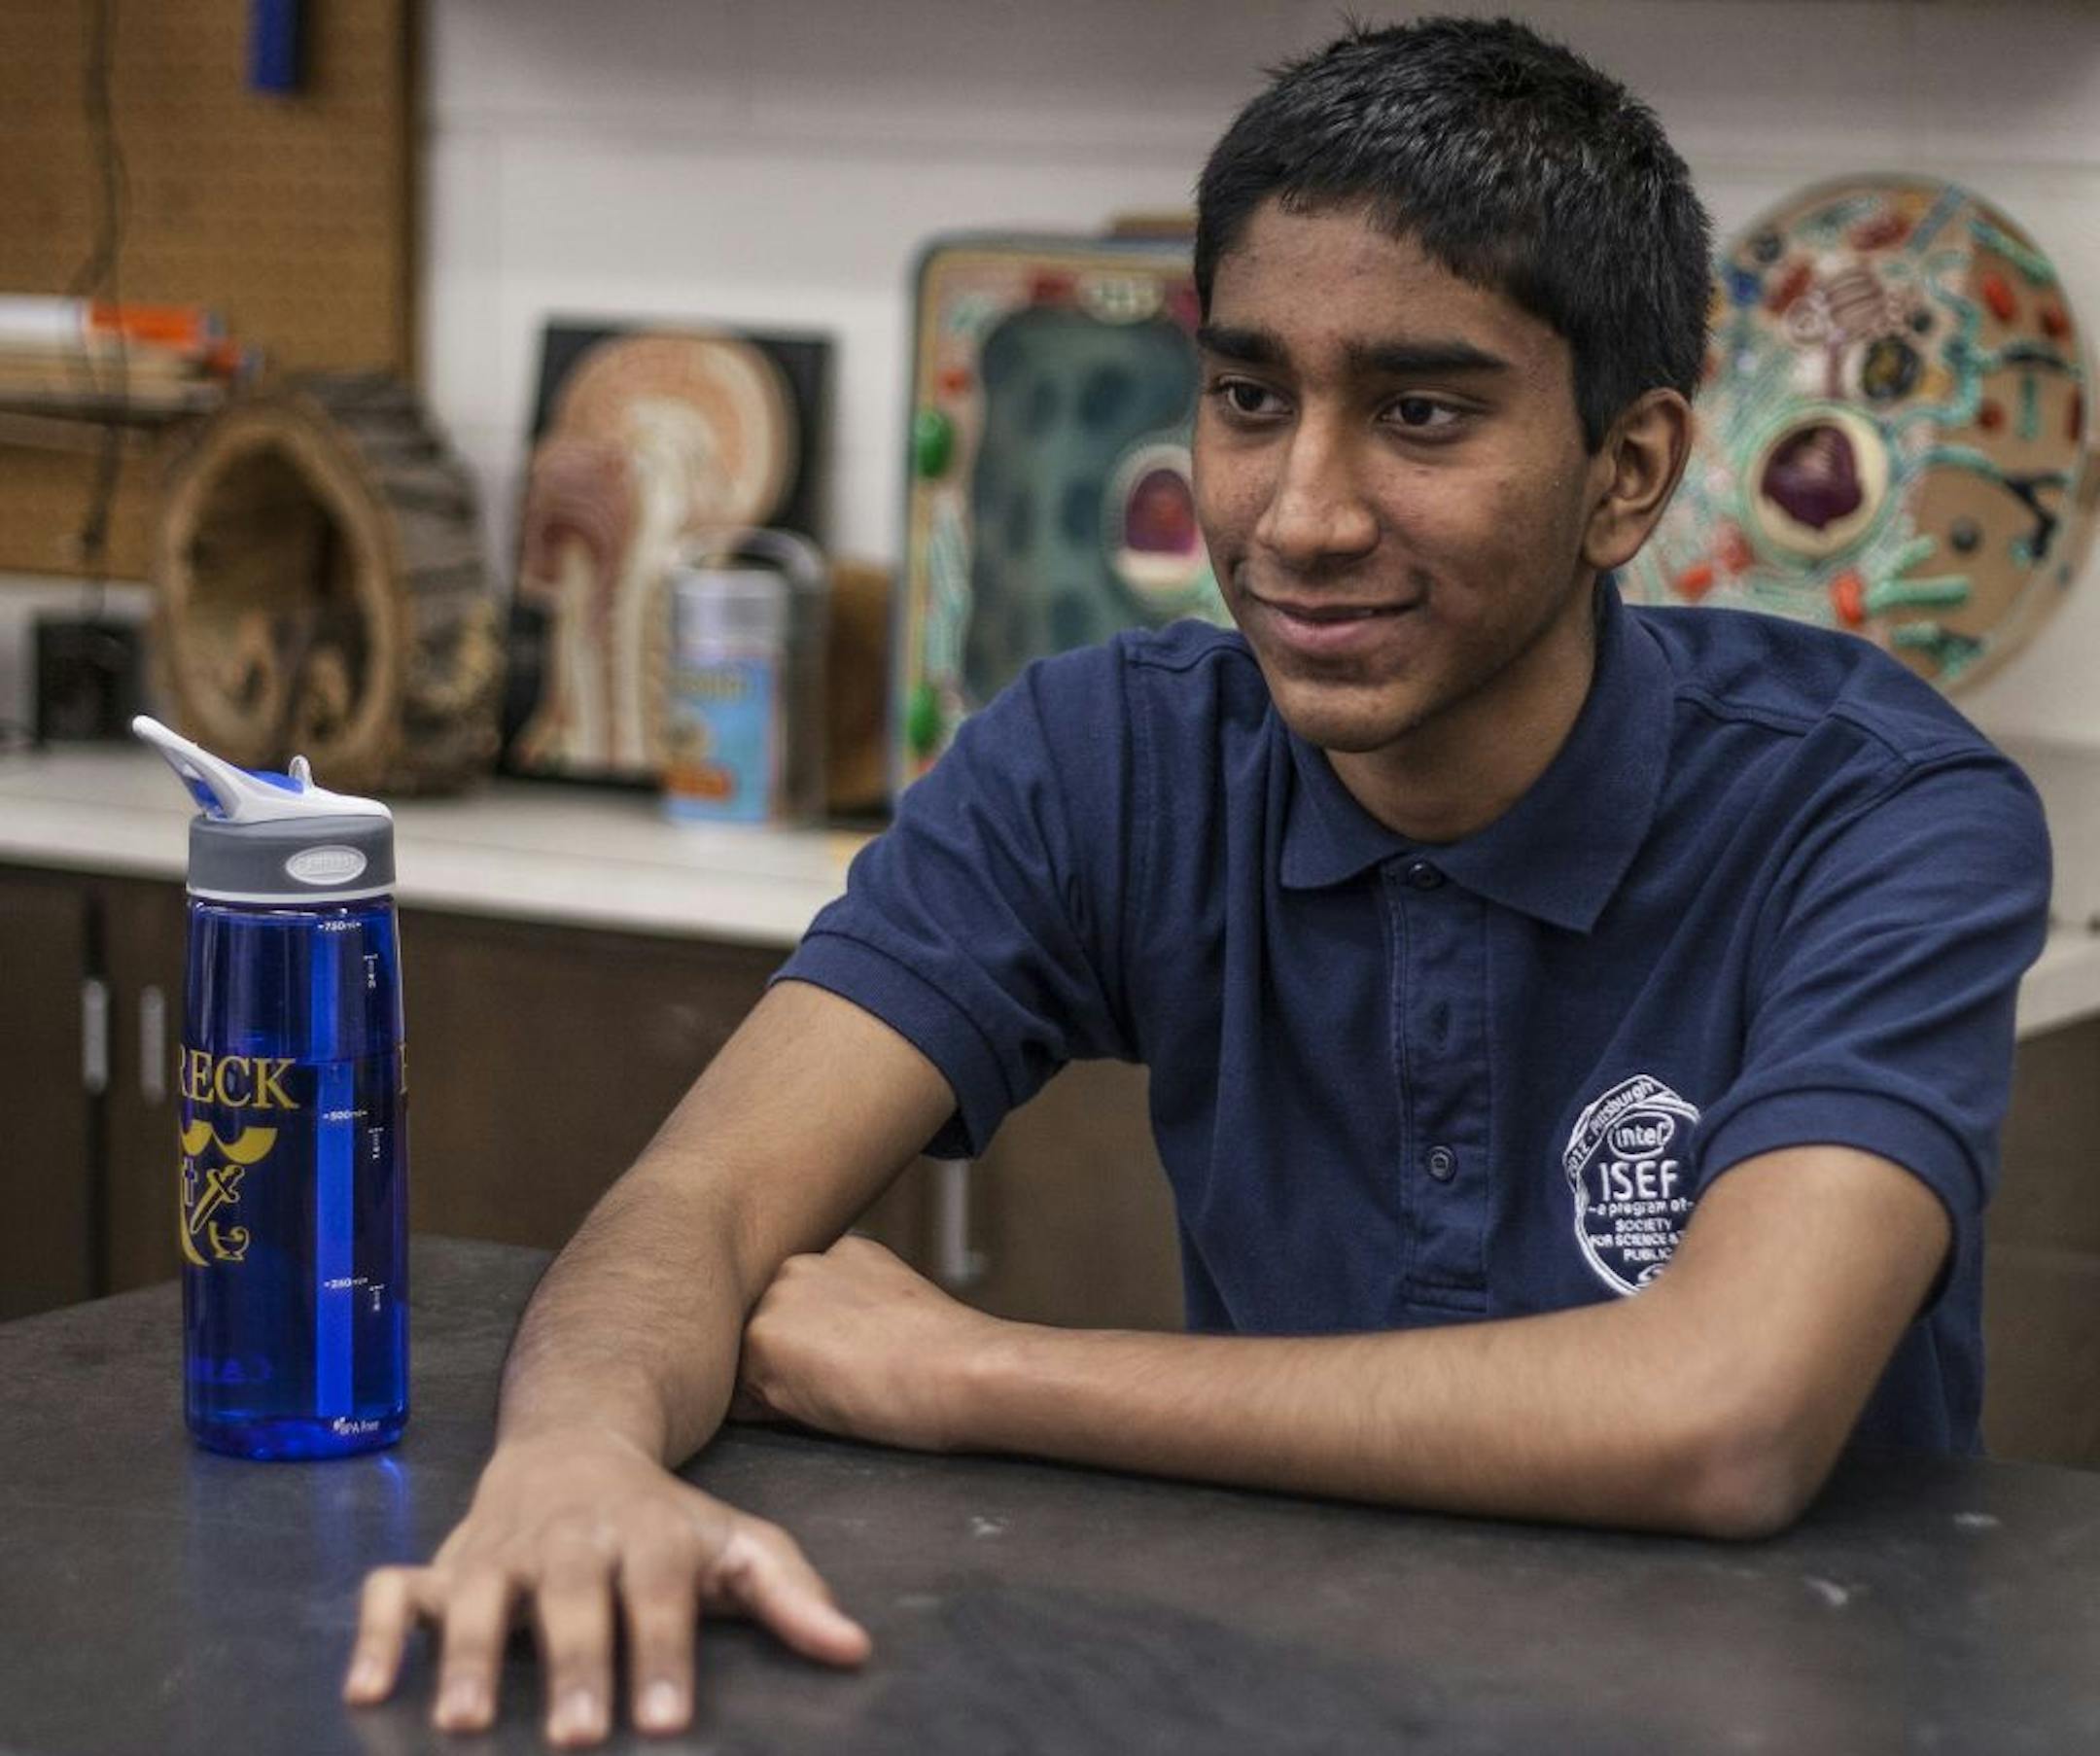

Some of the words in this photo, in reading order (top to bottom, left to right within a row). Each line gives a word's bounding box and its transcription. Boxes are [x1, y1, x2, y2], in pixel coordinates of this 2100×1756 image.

[1599, 1160, 1679, 1202] ISEF
[1609, 1200, 1667, 1217] program
[1615, 1217, 1672, 1233] SOCIETY
[1589, 1233, 1614, 1247] FOR
[1615, 1232, 1667, 1247] SCIENCE
[1623, 1247, 1673, 1262] PUBLIC
